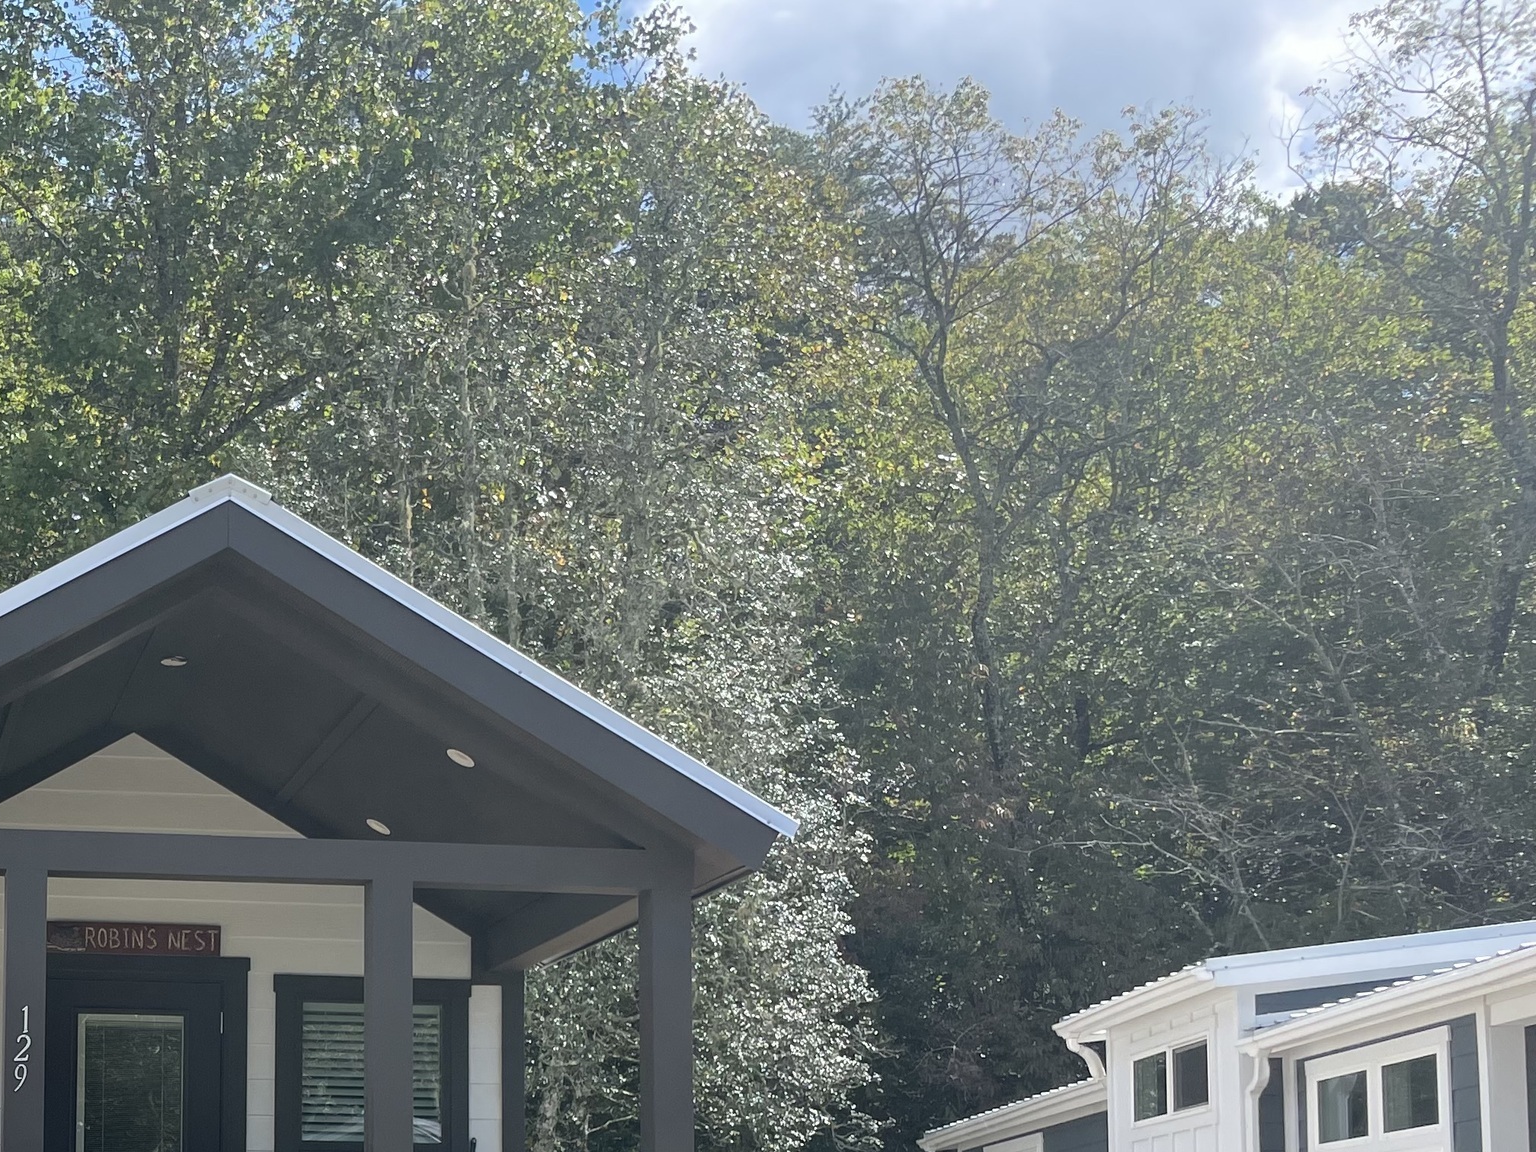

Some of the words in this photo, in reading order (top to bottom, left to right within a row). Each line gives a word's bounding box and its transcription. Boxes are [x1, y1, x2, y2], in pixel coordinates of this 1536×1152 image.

[85, 926, 158, 949] ROBIN'S
[168, 929, 219, 952] NEST
[13, 1005, 32, 1092] 129
